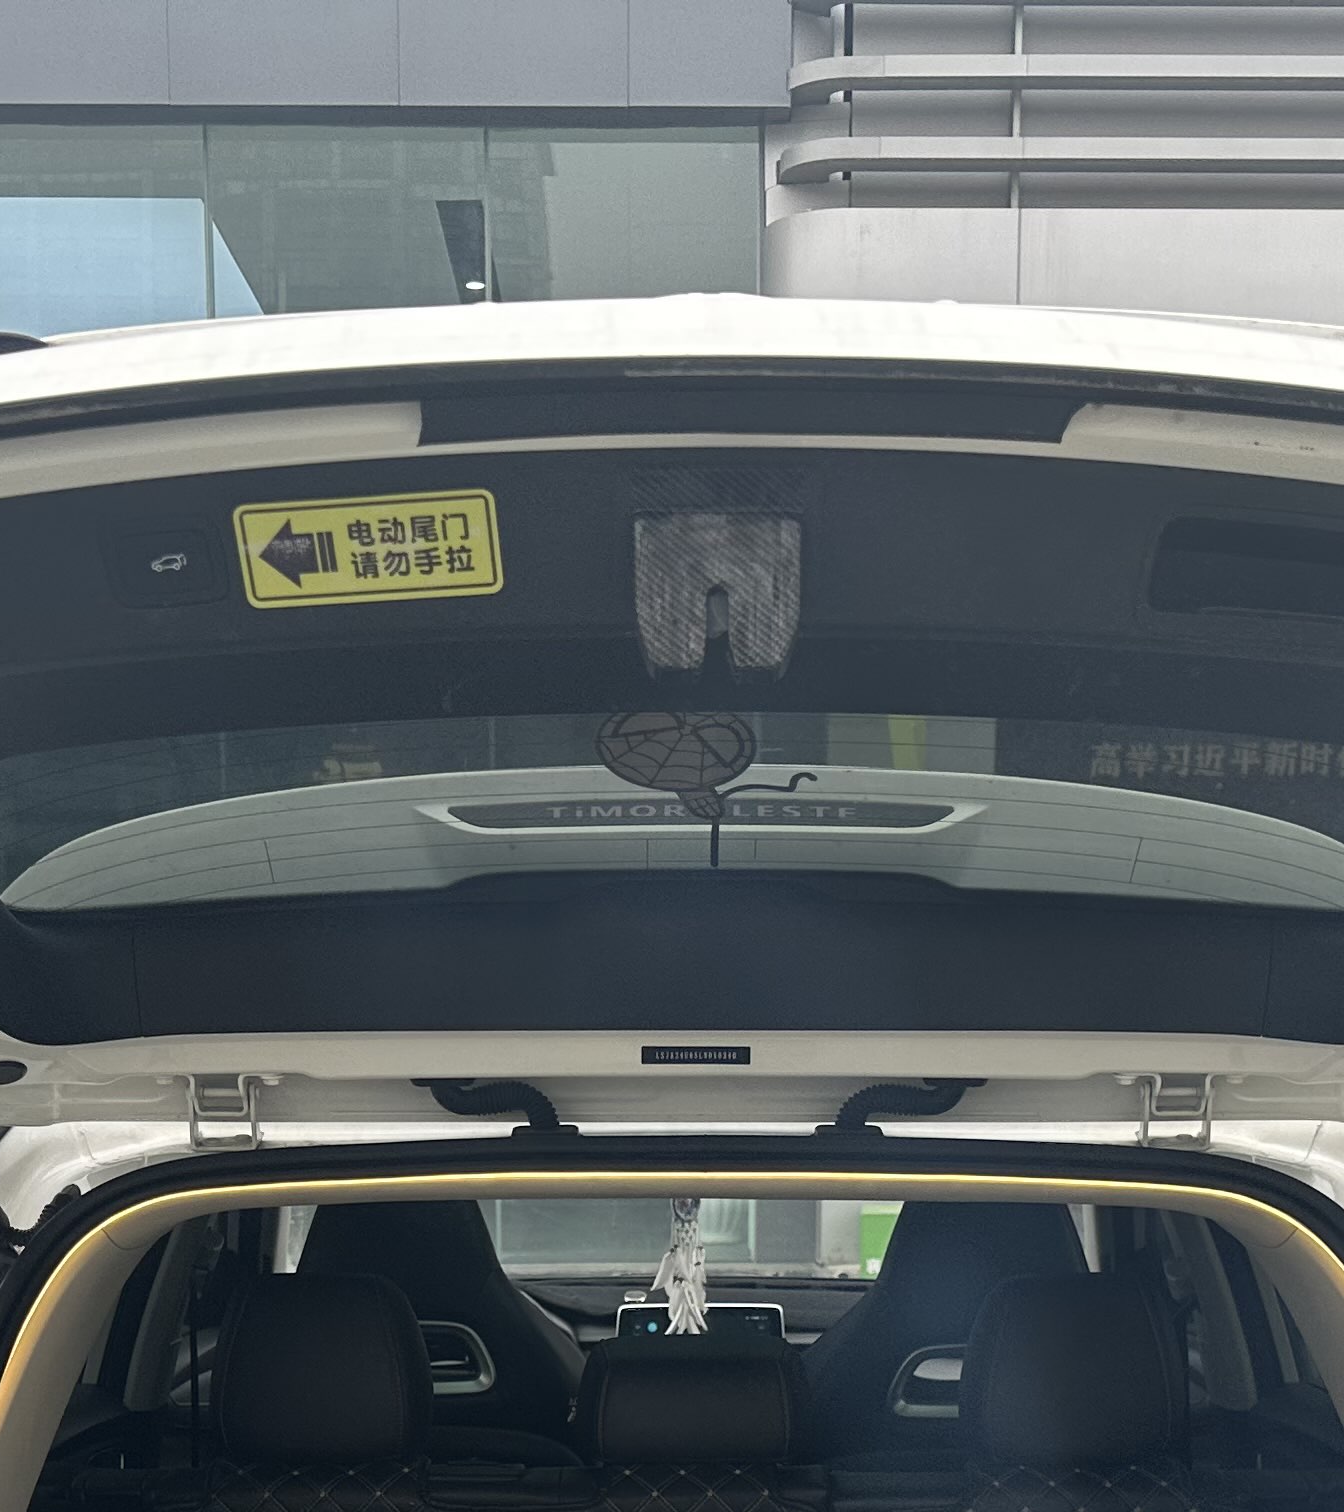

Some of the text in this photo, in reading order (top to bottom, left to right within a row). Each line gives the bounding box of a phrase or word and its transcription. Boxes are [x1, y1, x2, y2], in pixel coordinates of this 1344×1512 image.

[346, 512, 470, 548] 电动尾门
[350, 545, 476, 580] 请勿手拉
